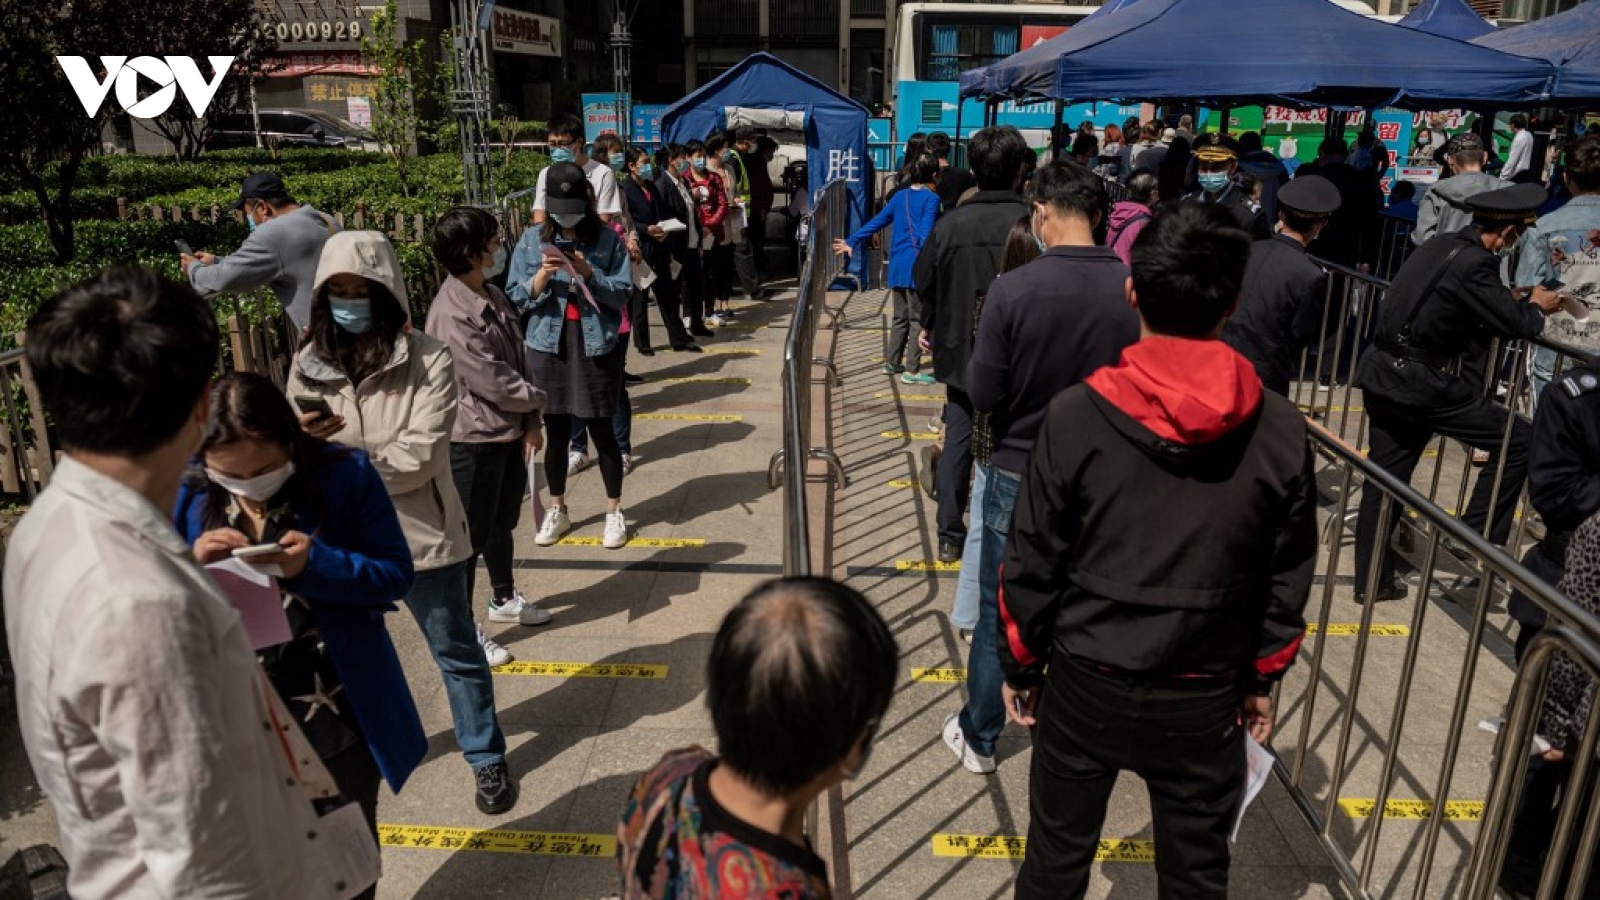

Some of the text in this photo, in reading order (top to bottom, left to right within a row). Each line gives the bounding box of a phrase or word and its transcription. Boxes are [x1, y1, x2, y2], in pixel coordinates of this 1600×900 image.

[251, 22, 361, 40] 2000929
[825, 148, 860, 182] 胜
[520, 833, 546, 841] Wait
[550, 835, 588, 843] Please
